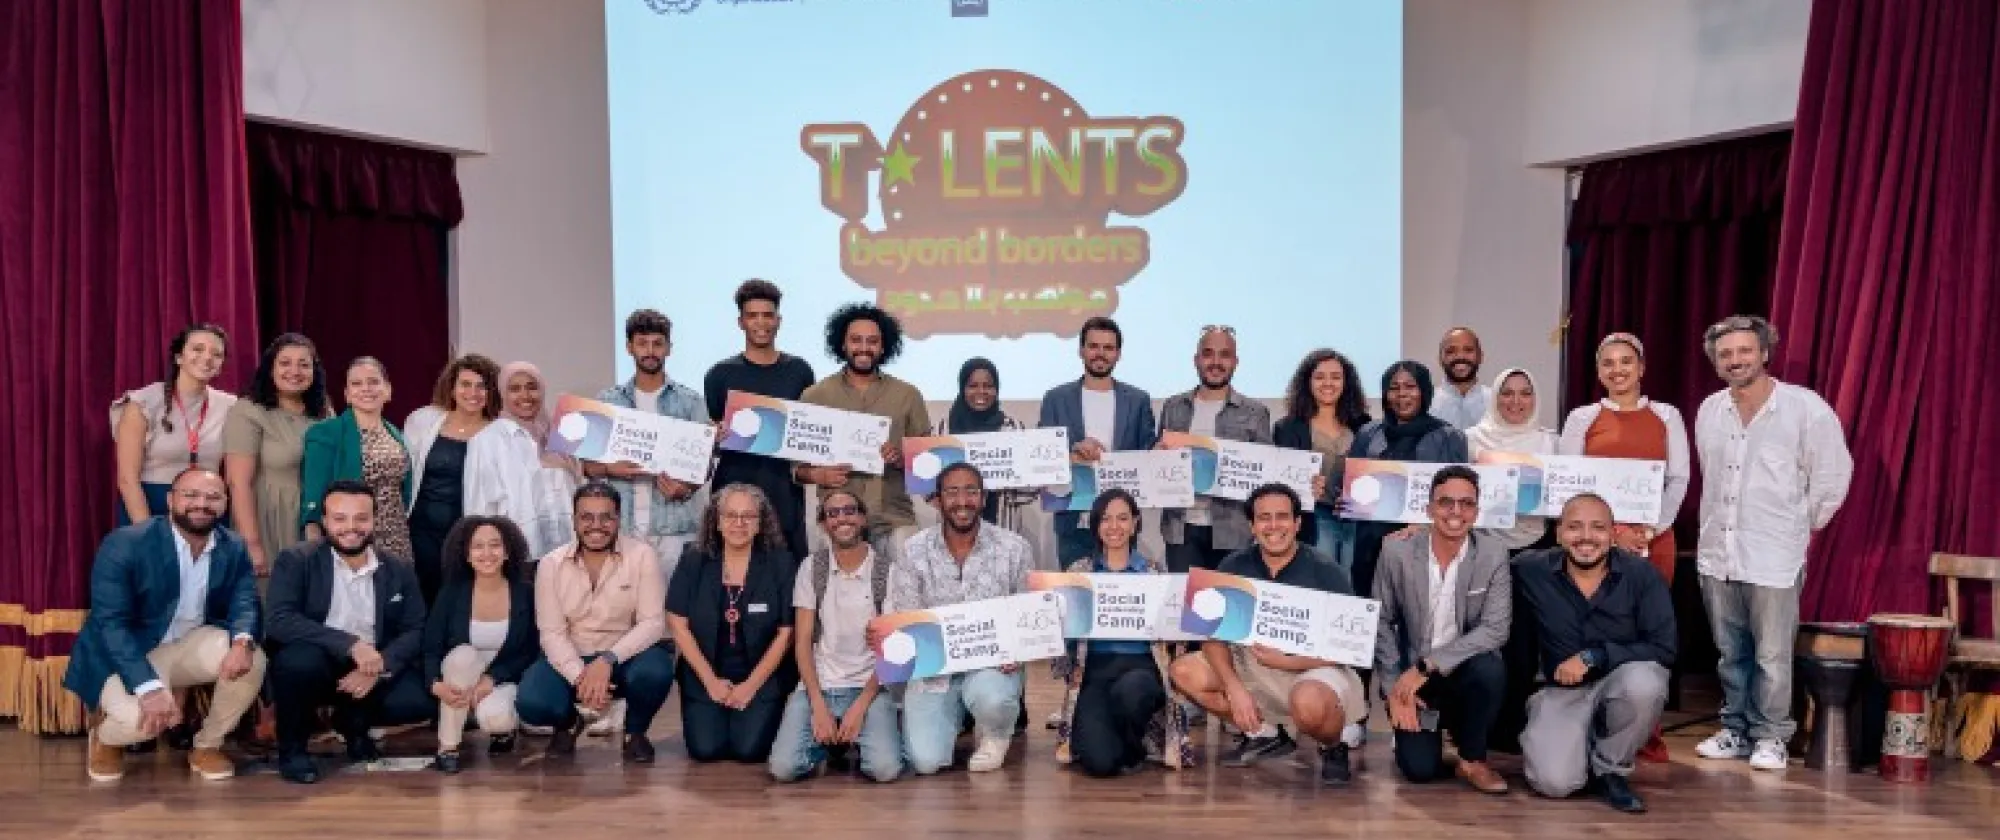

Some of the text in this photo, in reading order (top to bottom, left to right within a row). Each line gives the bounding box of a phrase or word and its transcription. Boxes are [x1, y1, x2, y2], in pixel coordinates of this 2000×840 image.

[849, 226, 1142, 273] beyond borders
[614, 423, 658, 441] Social
[789, 417, 833, 436] Social
[786, 436, 831, 456] Camp
[969, 447, 1013, 461] Social
[1219, 454, 1263, 472] Social
[982, 467, 1015, 481] amp
[1097, 467, 1139, 480] Social
[1547, 472, 1597, 486] Social
[1097, 592, 1146, 605] Social
[1258, 600, 1310, 621] Social
[945, 618, 995, 636] Social
[1097, 613, 1146, 631] Camp
[1256, 621, 1308, 647] Camp
[948, 642, 1000, 660] Camp
